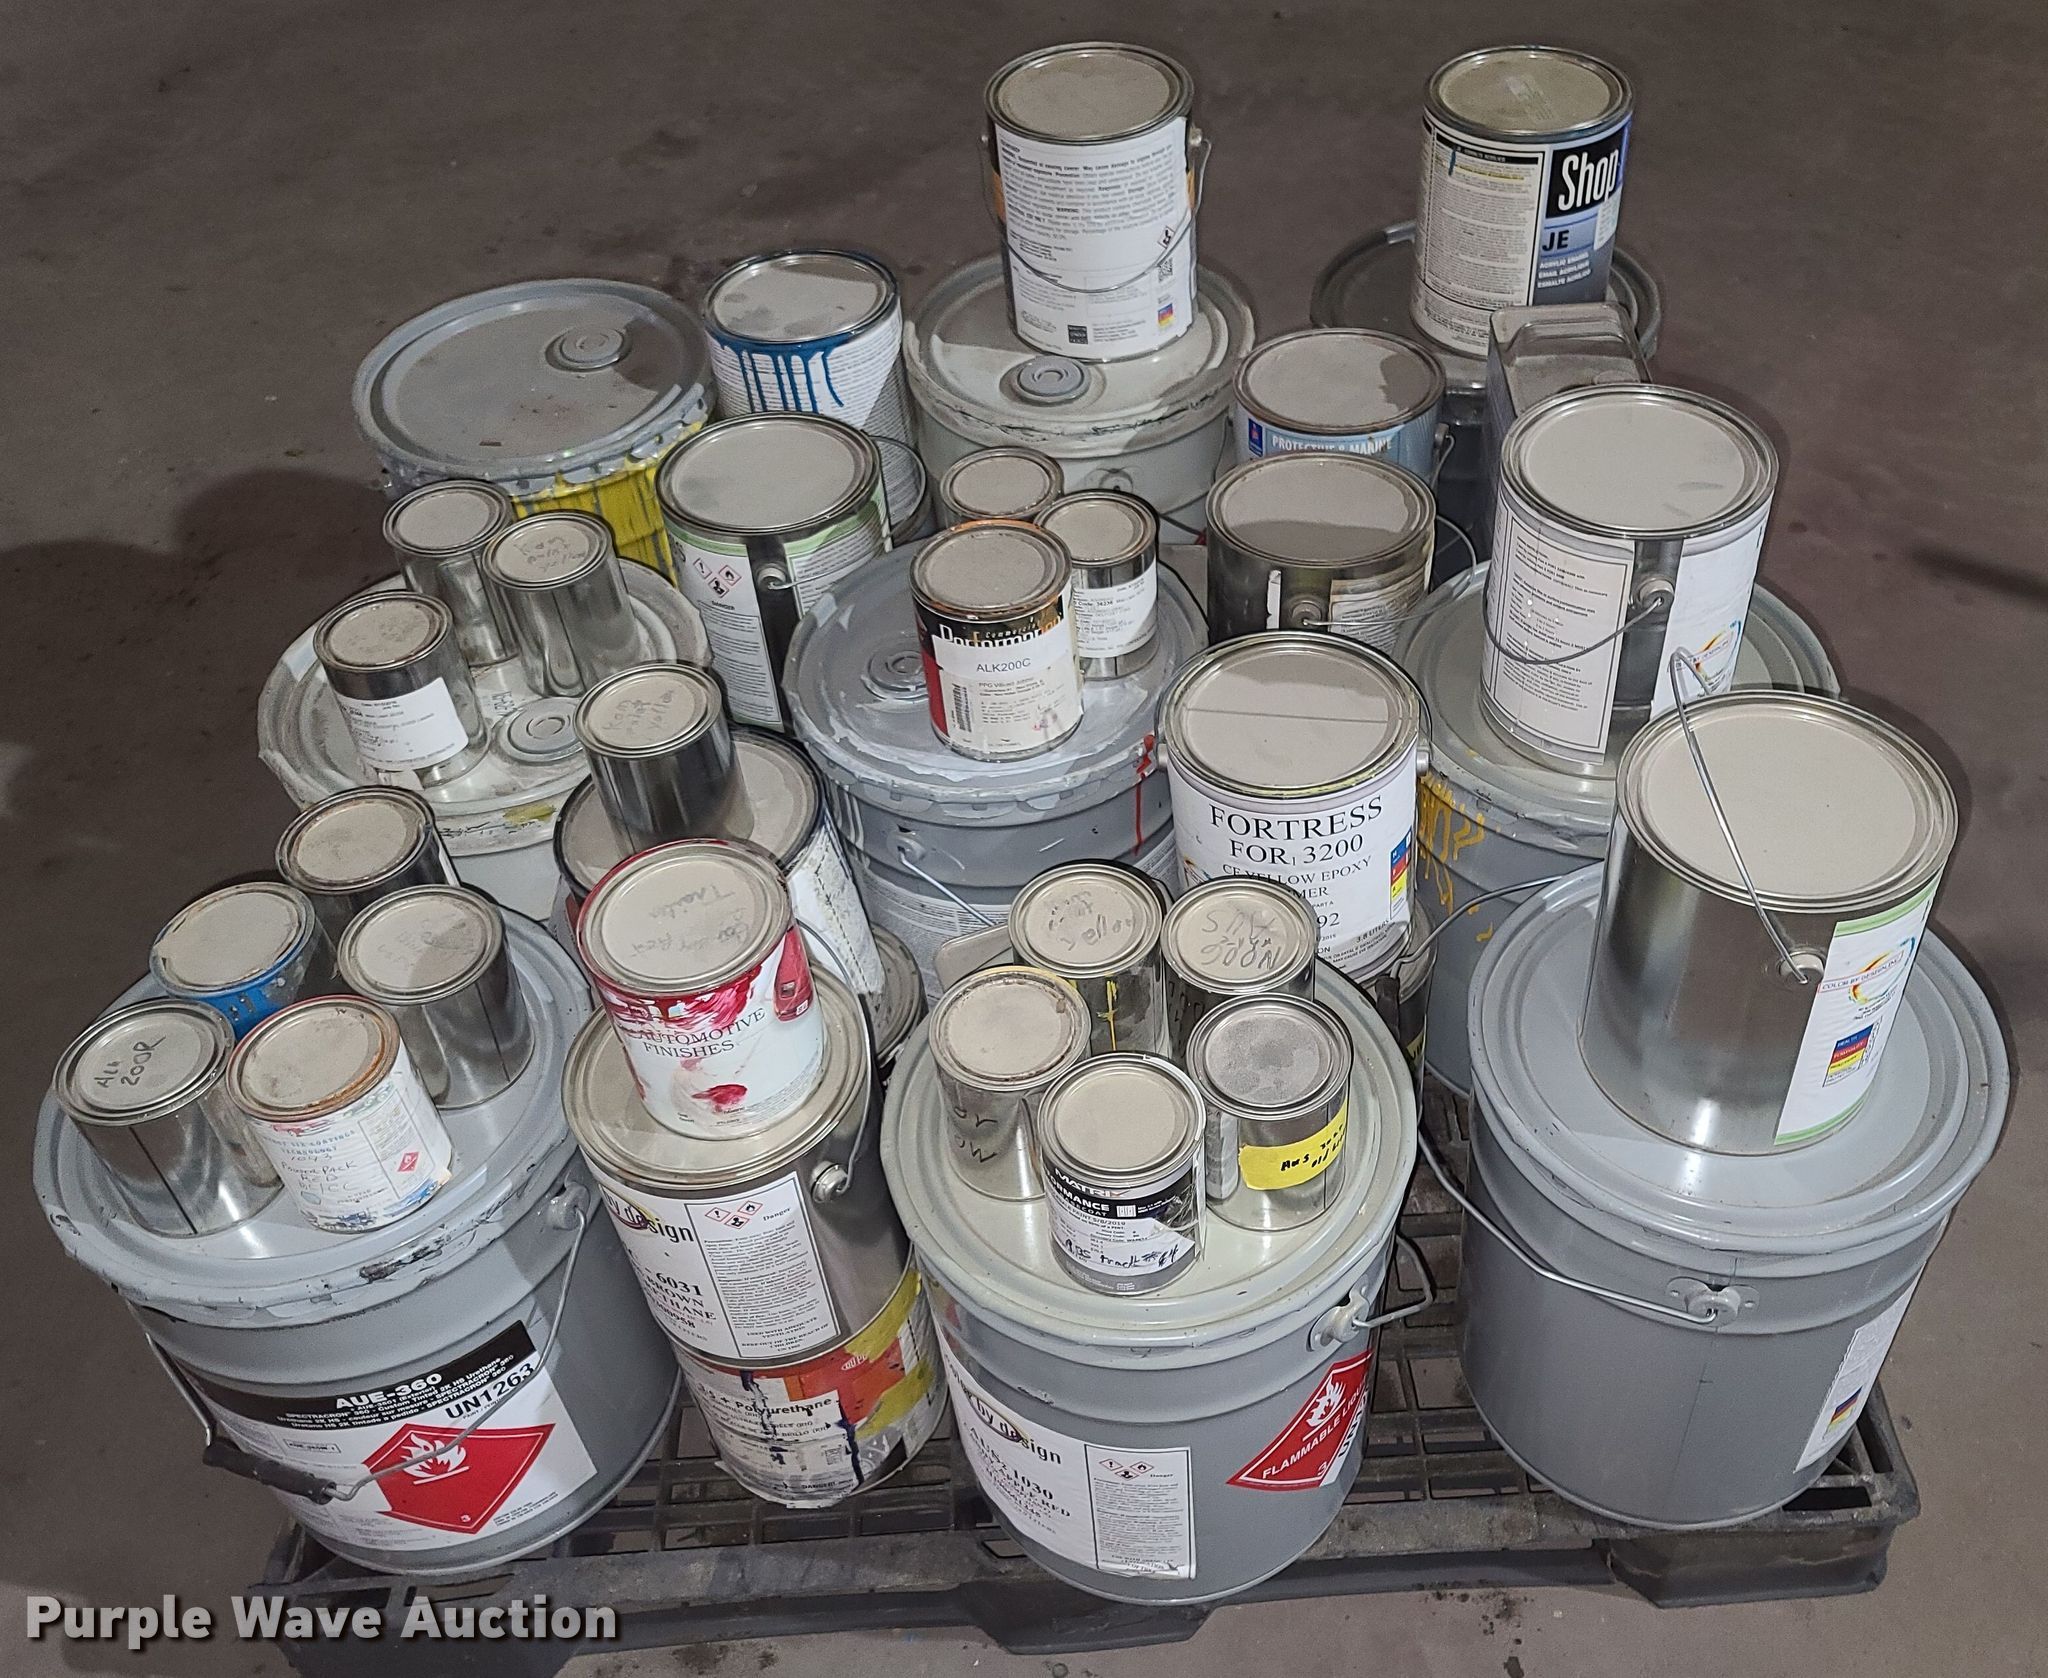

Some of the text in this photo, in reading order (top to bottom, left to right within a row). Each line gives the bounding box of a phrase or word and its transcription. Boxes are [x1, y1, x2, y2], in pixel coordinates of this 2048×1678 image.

[1558, 149, 1619, 211] Shop
[976, 658, 1031, 673] ALK200C
[1210, 795, 1382, 840] FORTRESS
[1302, 834, 1363, 865] 3200
[1321, 855, 1372, 882] EPOXY
[1316, 912, 1340, 928] 92
[641, 1008, 765, 1046] AUTOMOTIVE
[643, 1039, 735, 1059] FINISHES
[1050, 1176, 1110, 1212] ORMANCE
[1055, 1168, 1130, 1198] MATRIX
[763, 1208, 791, 1221] Danger
[1064, 1198, 1108, 1217] ASECOAT
[624, 1205, 694, 1244] design
[656, 1273, 703, 1297] 6031
[336, 1373, 442, 1409] AUE-360
[445, 1363, 534, 1419] UN1263
[735, 1397, 832, 1416] Polyurethane
[976, 1397, 1061, 1465] by design
[1262, 1415, 1341, 1480] FLAMMABLE
